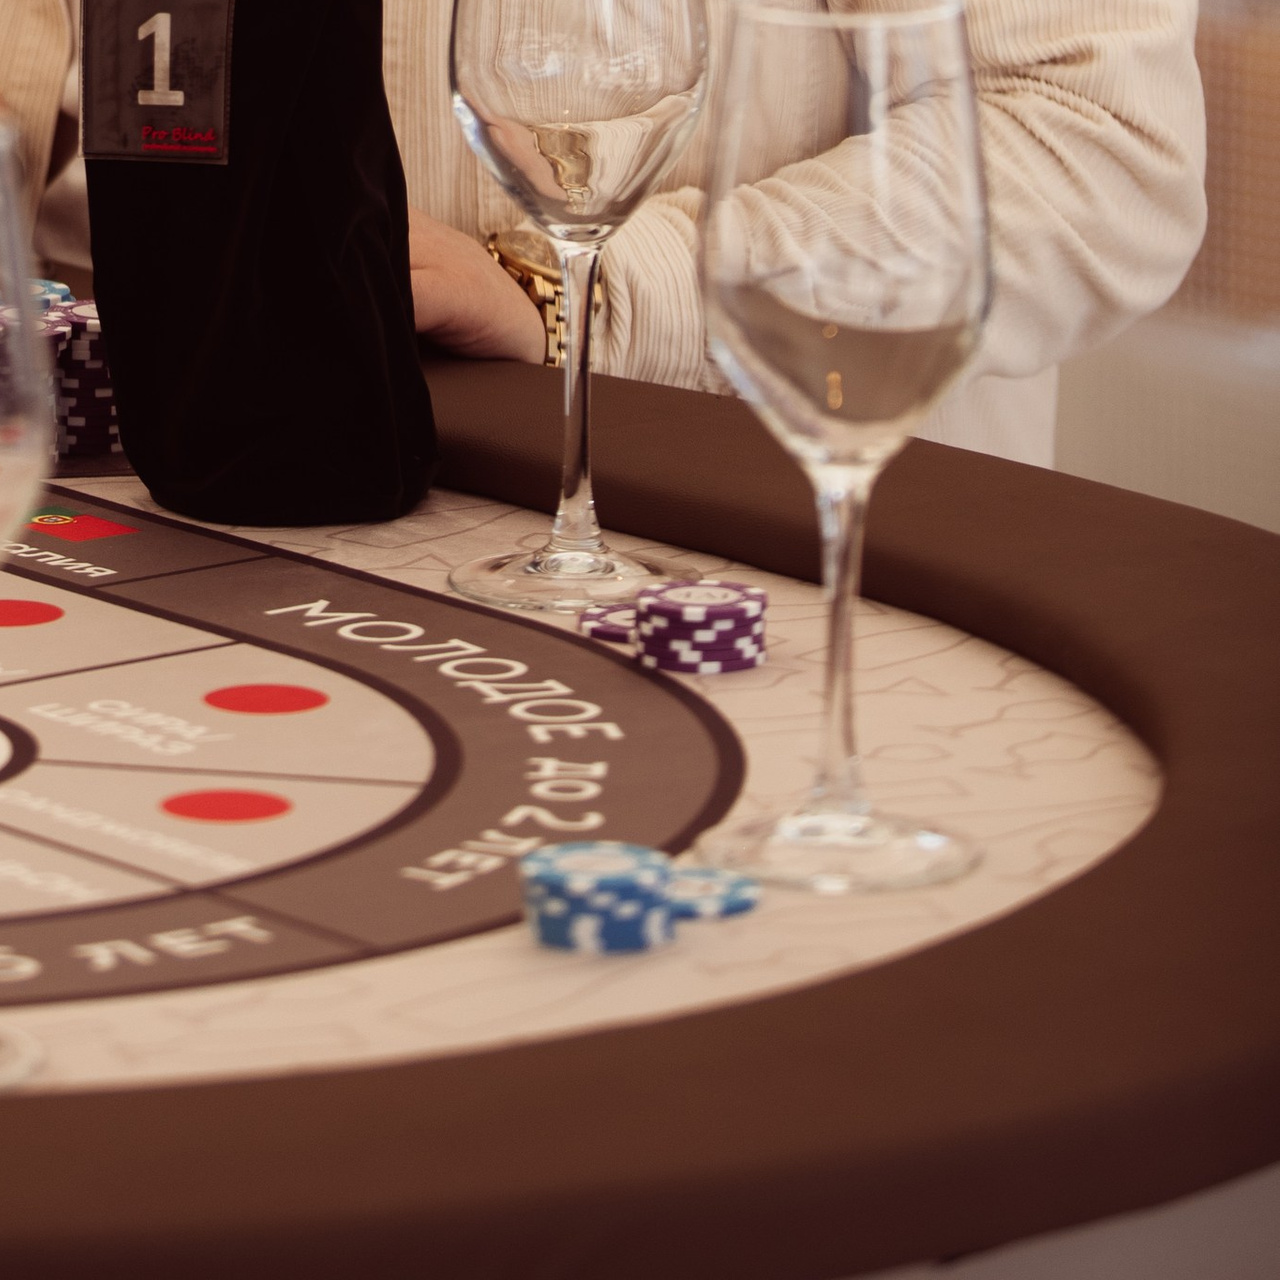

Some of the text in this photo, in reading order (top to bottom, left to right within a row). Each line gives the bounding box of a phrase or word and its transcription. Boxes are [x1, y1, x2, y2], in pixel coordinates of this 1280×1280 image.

[137, 12, 185, 107] 1
[141, 125, 216, 141] Pro Blind
[264, 598, 626, 891] МОЛОДОЕ ДО 2 ЛЕТ
[74, 915, 275, 973] ЛЕТ
